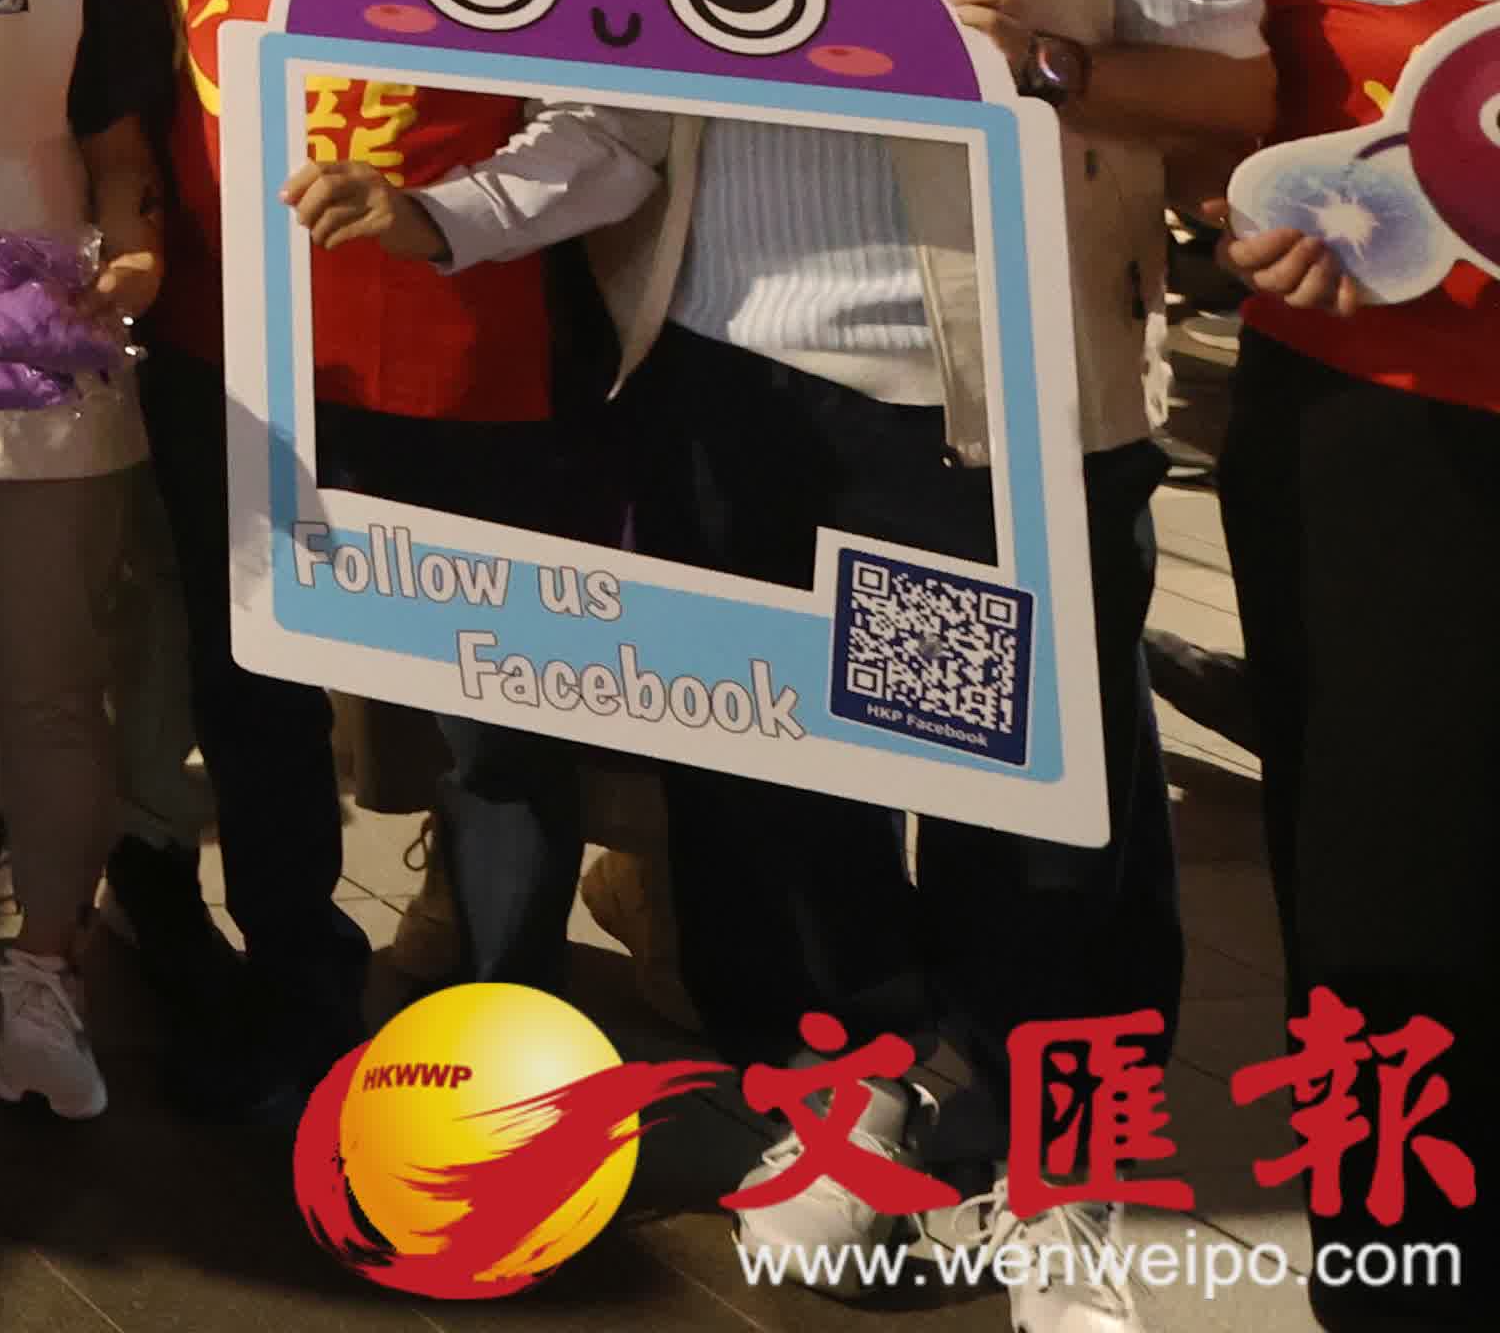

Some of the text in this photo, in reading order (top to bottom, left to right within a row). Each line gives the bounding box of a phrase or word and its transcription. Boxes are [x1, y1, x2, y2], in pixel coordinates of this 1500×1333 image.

[291, 521, 623, 622] Follow us
[455, 630, 806, 741] Facebook
[866, 702, 989, 748] HKP Facebook
